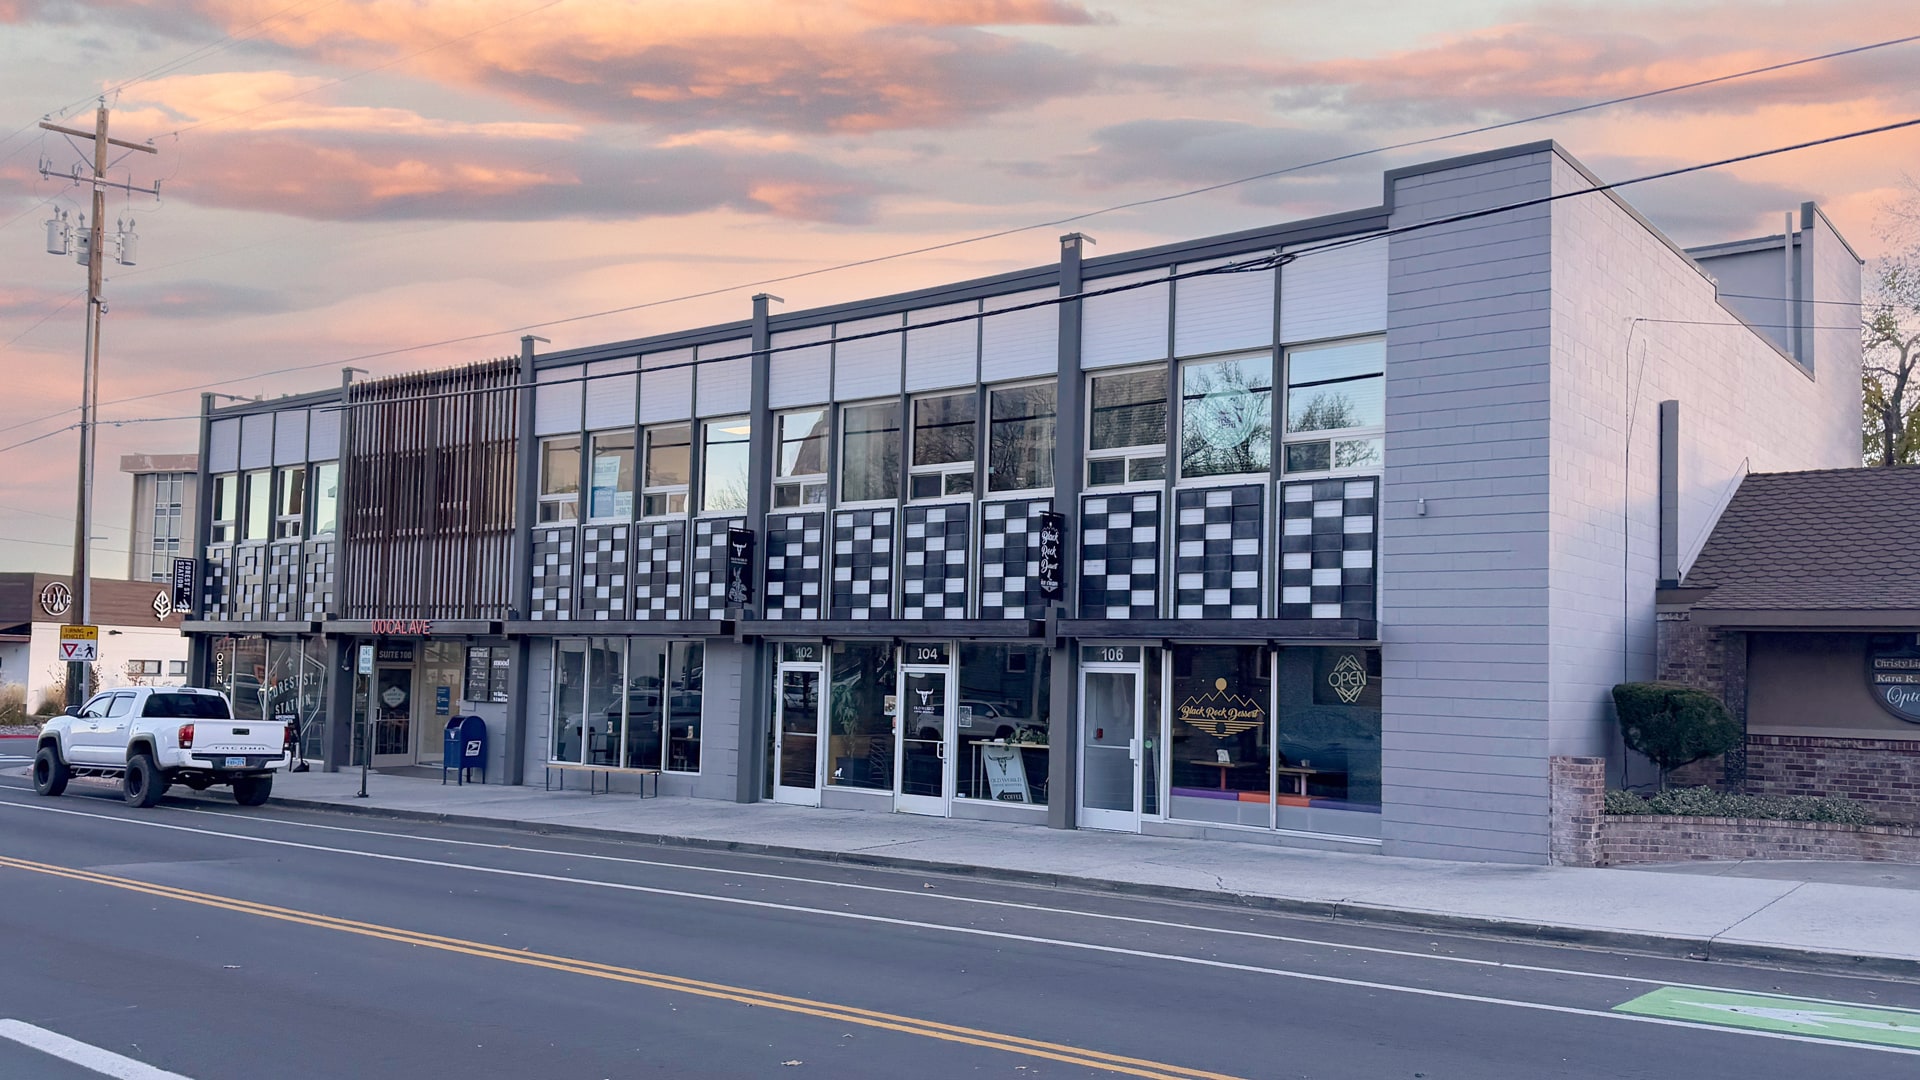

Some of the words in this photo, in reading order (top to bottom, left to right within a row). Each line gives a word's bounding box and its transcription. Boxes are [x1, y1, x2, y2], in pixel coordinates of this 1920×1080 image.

[1041, 531, 1059, 545] Black
[1041, 545, 1057, 560] Rock
[177, 561, 185, 589] STATION
[183, 561, 192, 587] FOREST
[371, 619, 386, 635] 100
[387, 619, 407, 634] CAL
[408, 619, 431, 635] AVE
[379, 651, 399, 659] SUITE
[400, 651, 412, 659] 100
[796, 647, 813, 658] 102
[918, 648, 938, 660] 104
[1101, 648, 1124, 662] 106
[1874, 658, 1907, 668] Christy
[1328, 670, 1367, 687] OPEN
[1876, 674, 1902, 683] Kara
[1905, 674, 1919, 683] R.
[267, 674, 300, 702] FOREST
[303, 672, 317, 686] ST.
[1181, 705, 1205, 719] Black
[1205, 706, 1228, 720] Rock
[1227, 707, 1260, 721] Dessert
